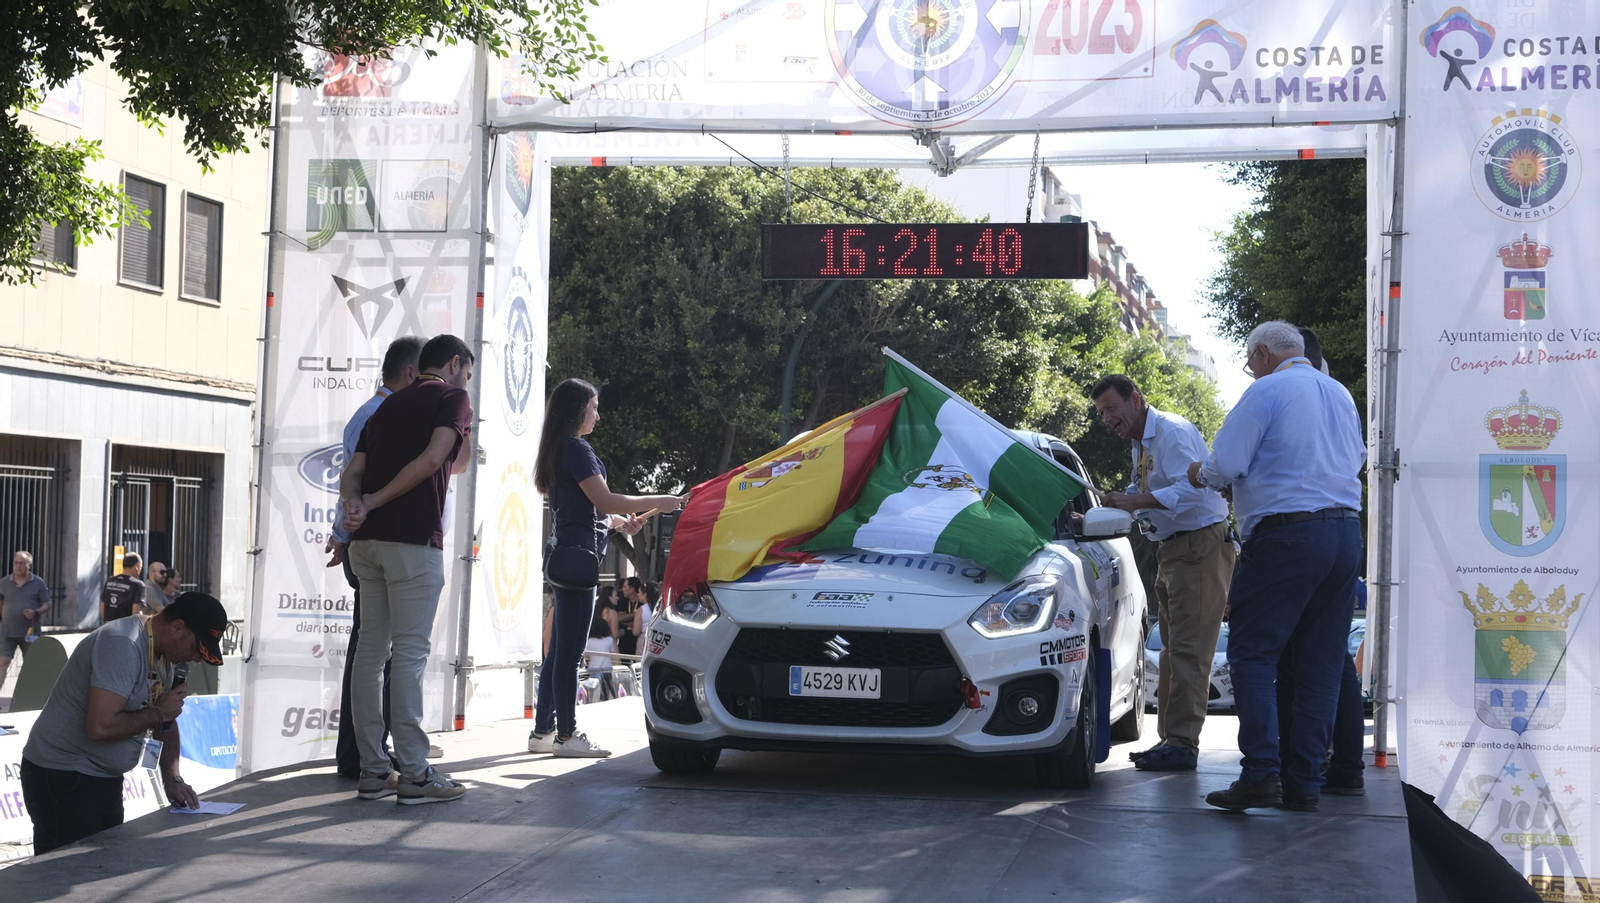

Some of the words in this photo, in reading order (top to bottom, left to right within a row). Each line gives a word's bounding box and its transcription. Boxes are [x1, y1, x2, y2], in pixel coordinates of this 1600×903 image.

[1256, 46, 1343, 67] COSTA
[1351, 45, 1384, 66] DE
[1503, 36, 1587, 57] COSTA
[587, 79, 684, 101] ALMERÍA
[1229, 67, 1387, 104] ALMERÍA
[856, 87, 867, 97] 30
[866, 94, 876, 104] de
[944, 100, 976, 116] octubre
[975, 85, 995, 103] 2023
[321, 106, 385, 117] DEPORTES
[388, 106, 405, 117] DE
[1479, 119, 1544, 157] AUTOMOVIL
[1551, 128, 1575, 156] CLUB
[1496, 205, 1555, 219] ALMERIA
[820, 228, 1022, 275] 16:21:40
[1438, 329, 1542, 346] Ayuntamiento
[1547, 328, 1565, 342] de
[1450, 355, 1508, 375] Corazón
[1511, 350, 1534, 366] del
[1537, 347, 1599, 366] Poniente
[1456, 565, 1519, 575] Ayuntamiento
[1520, 565, 1532, 574] de
[1534, 566, 1580, 576] Alboloduy
[278, 592, 334, 611] Diario
[1040, 634, 1086, 655] CMMOTOR
[1064, 648, 1086, 663] SPORT
[803, 672, 843, 691] 4529
[848, 673, 878, 692] KVJ
[1438, 740, 1502, 750] Ayuntamiento
[1503, 741, 1515, 750] de
[1516, 742, 1551, 751] Alhama
[1552, 743, 1565, 752] de
[1502, 833, 1543, 844] CERCA
